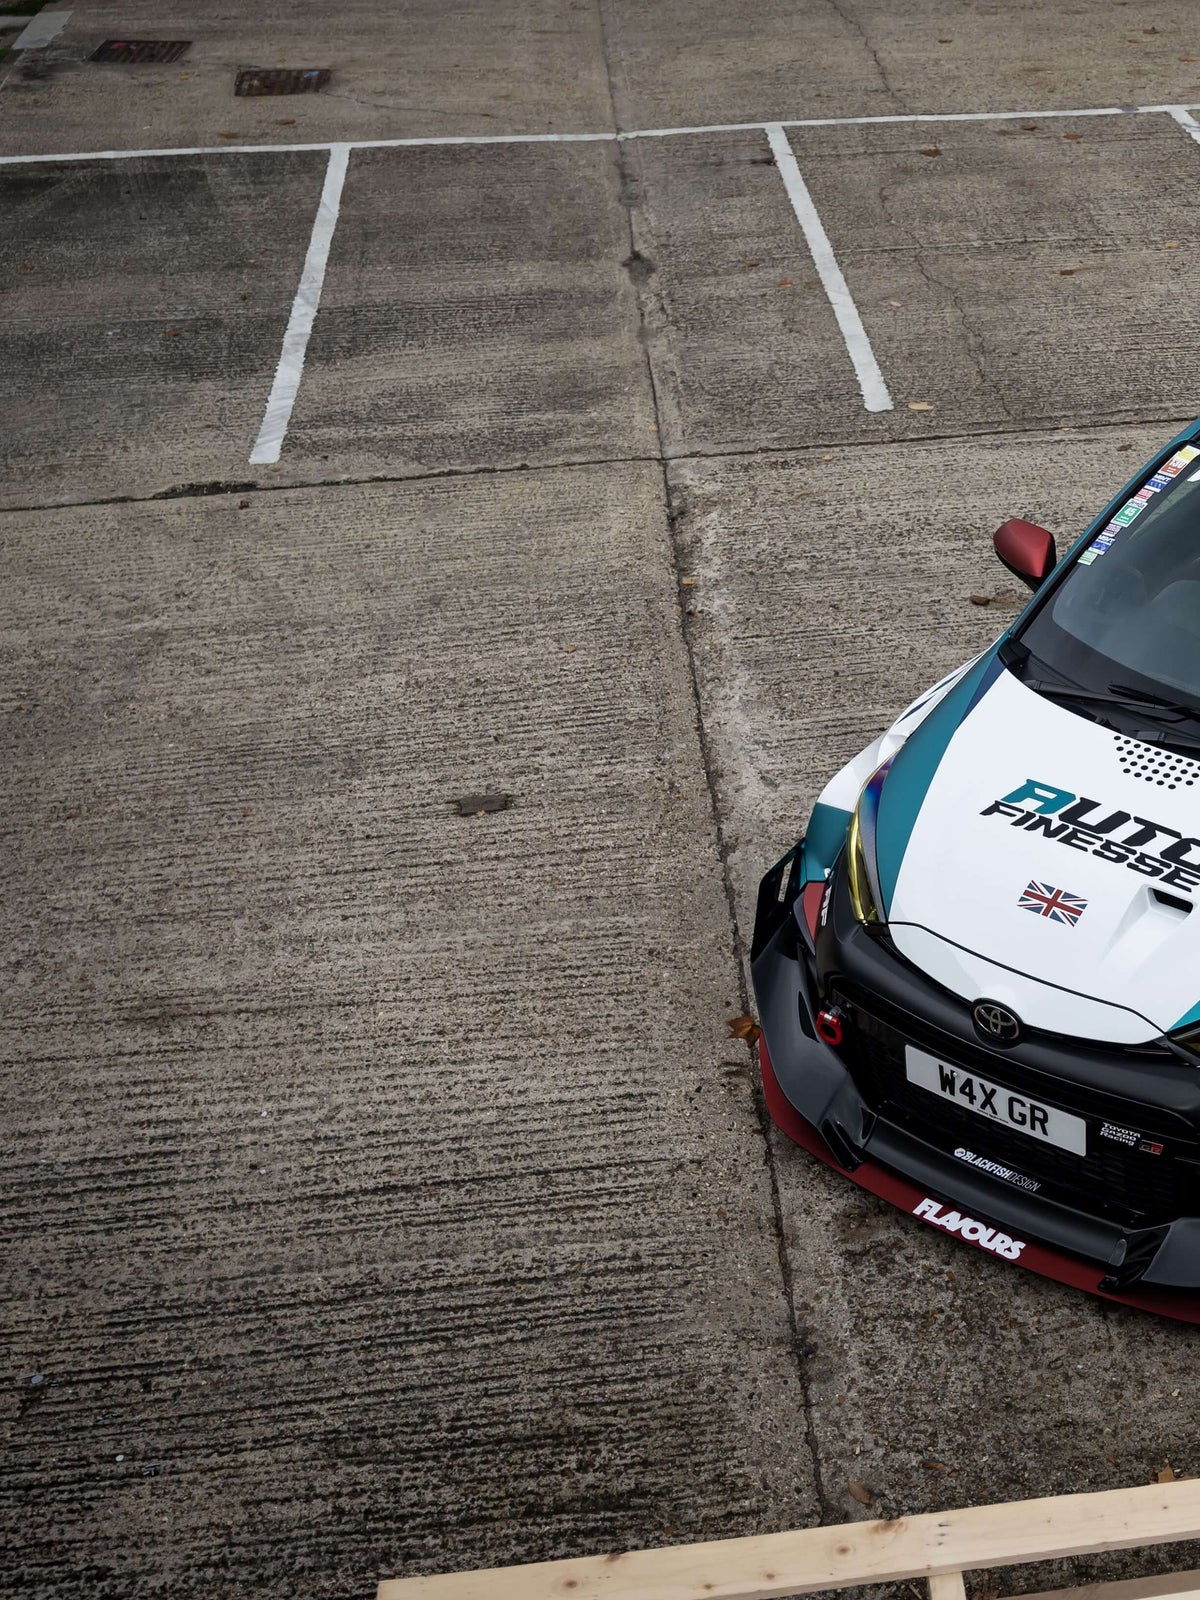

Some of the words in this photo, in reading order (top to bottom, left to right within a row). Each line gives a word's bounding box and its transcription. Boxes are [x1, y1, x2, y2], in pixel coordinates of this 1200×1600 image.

[938, 1064, 999, 1111] W4X
[1008, 1096, 1049, 1136] GR
[912, 1198, 1027, 1261] FLAVOURS
